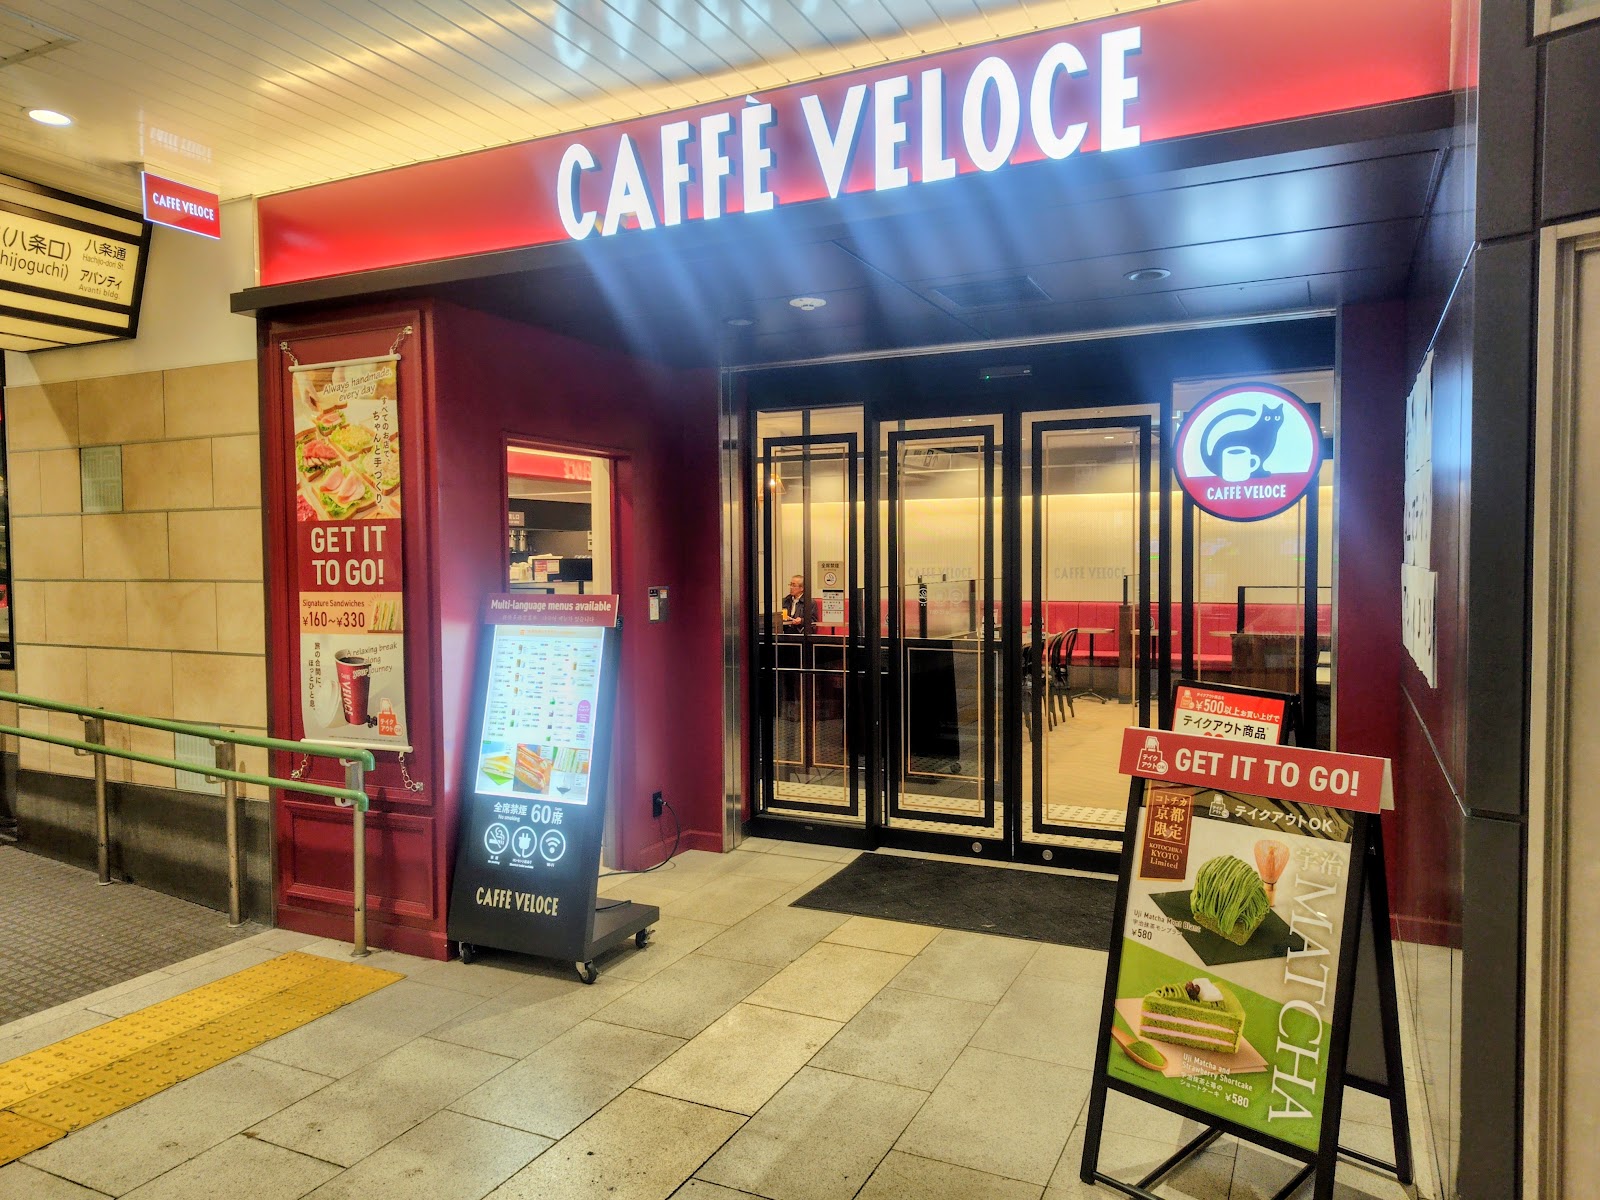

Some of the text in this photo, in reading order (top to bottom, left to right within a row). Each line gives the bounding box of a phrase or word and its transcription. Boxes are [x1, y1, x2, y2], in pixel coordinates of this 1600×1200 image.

[557, 94, 774, 240] CAFFÈ
[800, 26, 1141, 199] VELOCE
[182, 200, 214, 221] VELOCE
[0, 226, 72, 262] (八条口)
[84, 238, 127, 262] 八条通
[82, 253, 117, 269] Hachijo-dori
[78, 284, 120, 300] Avanti bldg.
[323, 380, 350, 396] Always
[339, 384, 376, 402] every day
[1244, 484, 1286, 499] VELOCE
[311, 525, 387, 554] GET IT
[312, 558, 384, 585] TO GO!
[302, 599, 365, 608] Signature Sandwiches
[491, 599, 612, 613] Multi-language menus available
[353, 645, 378, 655] relaxing
[379, 642, 398, 652] break
[1142, 753, 1158, 762] テイク
[1175, 748, 1360, 797] GET IT TO GO!
[493, 801, 528, 816] 全席禁煙
[1155, 794, 1188, 808] コトチカ
[1154, 805, 1185, 823] 京都
[1234, 804, 1333, 834] テイクアウトOK
[1153, 821, 1183, 841] 限定
[1149, 842, 1183, 855] KOTOCHIKA
[1151, 849, 1180, 862] KYOTO
[1150, 857, 1179, 870] Limited
[1296, 845, 1344, 878] 宇治
[515, 891, 559, 916] VELOCE
[1133, 909, 1142, 918] Uji
[1143, 911, 1165, 923] Matcha
[1131, 928, 1153, 941] ¥580
[1267, 873, 1338, 1122] MATCHA
[1183, 1052, 1231, 1075] Uji Matcha and
[1182, 1061, 1218, 1081] Strawberry
[1219, 1073, 1253, 1092] Shortcake
[1179, 1079, 1220, 1098] ショートケーキ
[1224, 1092, 1250, 1109] ¥580
